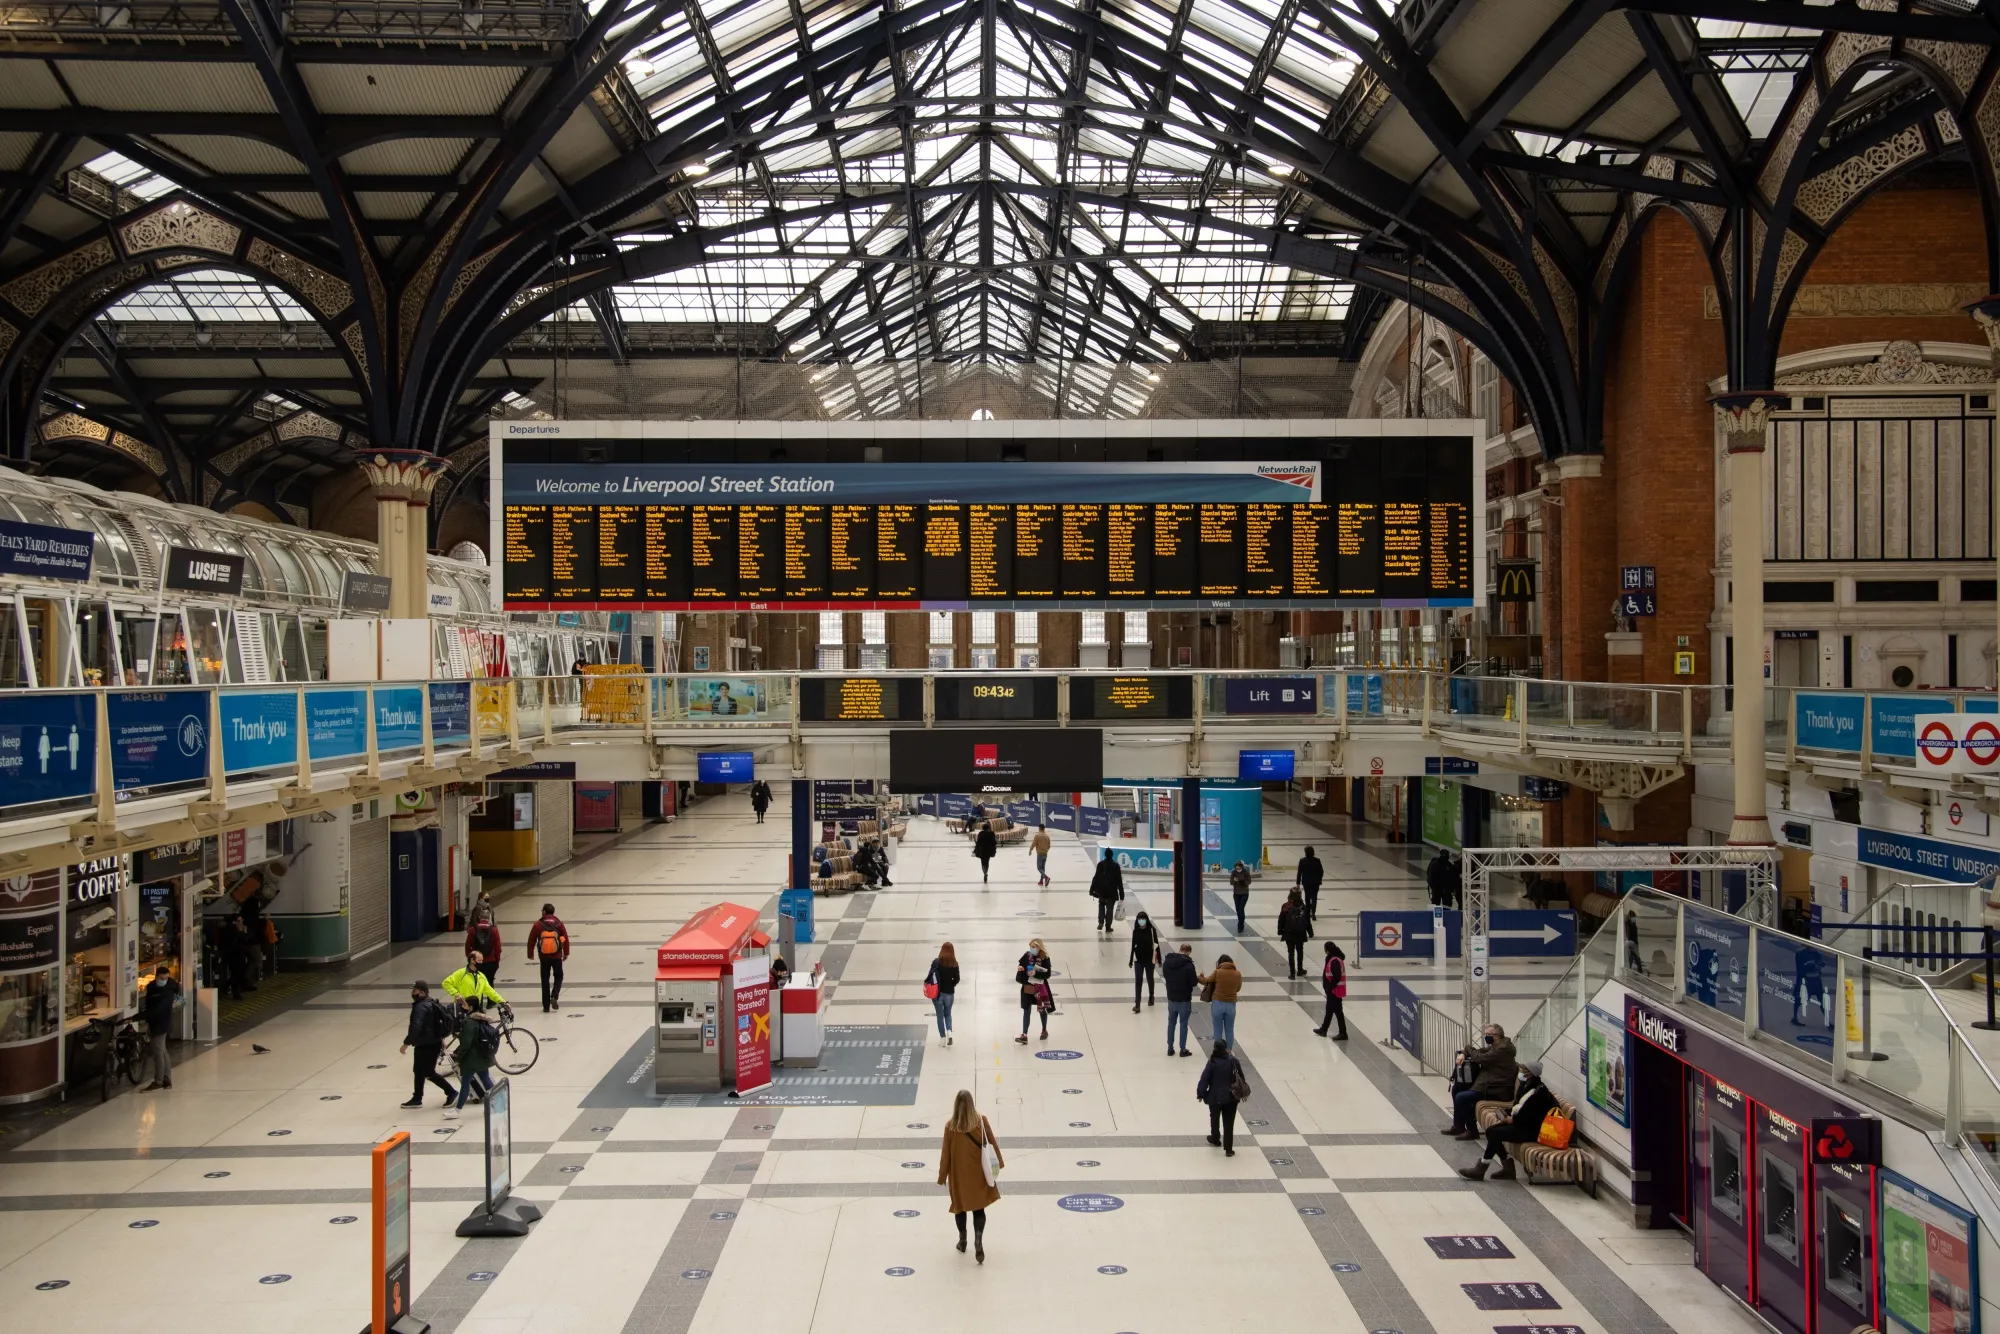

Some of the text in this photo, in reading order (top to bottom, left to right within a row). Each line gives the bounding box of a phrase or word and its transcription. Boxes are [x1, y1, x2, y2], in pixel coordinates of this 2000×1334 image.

[509, 425, 560, 436] Departures
[536, 476, 835, 497] Welcome to Liverpool Street Station
[0, 533, 90, 556] EAL'S YARD REMEDIES
[14, 552, 87, 571] Ethical Organic Health & Beauty
[188, 560, 218, 581] LUSH
[1211, 600, 1231, 608] West
[1250, 690, 1270, 701] Lift
[381, 707, 416, 730] Thank you
[1806, 709, 1854, 735] Thank you
[1879, 712, 1886, 721] To
[1897, 713, 1915, 723] amazi
[232, 716, 287, 744] Thank you
[1889, 728, 1911, 738] nation's
[2, 736, 20, 750] keep
[975, 758, 997, 766] crisis
[156, 844, 180, 859] PASTY
[1867, 840, 1913, 861] LIVERPOOL
[1917, 850, 1948, 868] STREET
[78, 869, 130, 901] COFFEE
[27, 925, 53, 937] Espresso
[1694, 925, 1732, 947] Let's travel safely
[662, 952, 724, 961] stanstedexpress
[1764, 968, 1794, 989] Please keep
[737, 988, 767, 1002] Flying from
[1763, 984, 1795, 1004] your distance
[737, 998, 766, 1012] Stansted?
[1638, 1010, 1678, 1052] NatWest
[1717, 1093, 1726, 1106] Cash
[1769, 1110, 1797, 1135] NatWest
[1770, 1125, 1781, 1138] Cash
[1844, 1170, 1852, 1180] out
[1452, 1238, 1465, 1247] here
[1466, 1237, 1482, 1250] queue
[1484, 1237, 1498, 1250] Please
[1491, 1284, 1506, 1295] here
[1506, 1284, 1525, 1299] queue
[1524, 1284, 1542, 1299] Please
